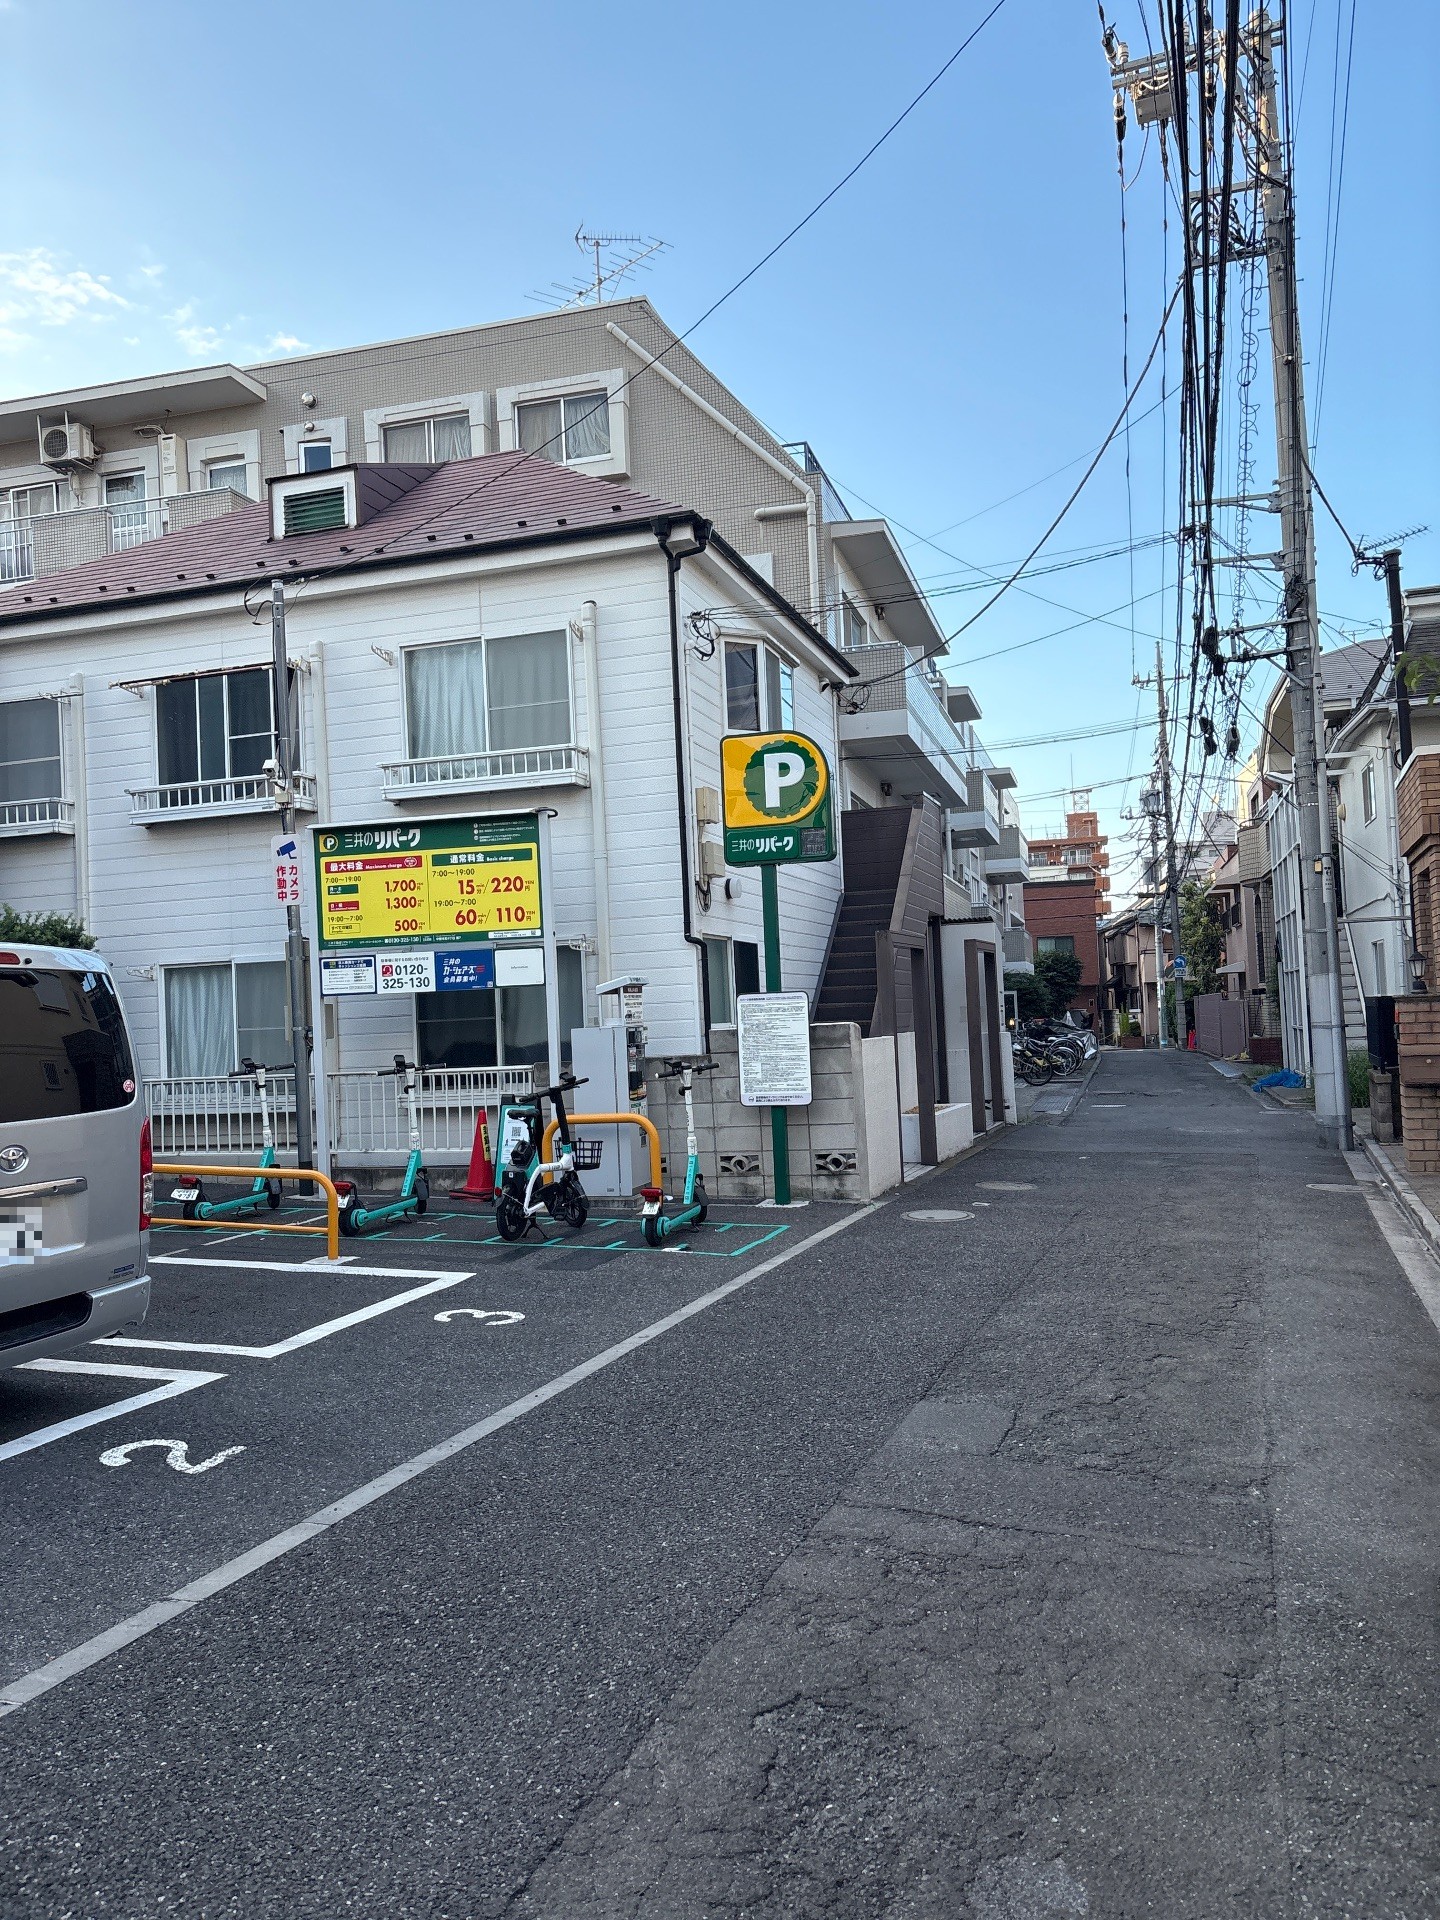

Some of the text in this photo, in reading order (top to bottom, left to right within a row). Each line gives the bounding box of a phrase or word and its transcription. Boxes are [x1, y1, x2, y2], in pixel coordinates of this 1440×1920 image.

[763, 752, 806, 809] P
[344, 828, 420, 849] 三井のリパーク
[731, 836, 794, 853] 三井のリパーク
[449, 852, 485, 864] 通常料金
[330, 861, 363, 872] 最大料金
[276, 865, 287, 902] 作動中
[289, 865, 299, 901] カメラ
[385, 879, 416, 893] 1,700
[458, 879, 475, 895] 15
[490, 875, 524, 893] 220
[385, 896, 417, 910] 1,300
[455, 909, 477, 925] 60
[496, 906, 525, 923] 110
[394, 919, 418, 932] 500
[395, 964, 428, 976] 0120-
[442, 958, 460, 966] 三井の
[382, 977, 430, 989] 325-130
[433, 1308, 526, 1326] 3
[99, 1439, 247, 1474] 2
